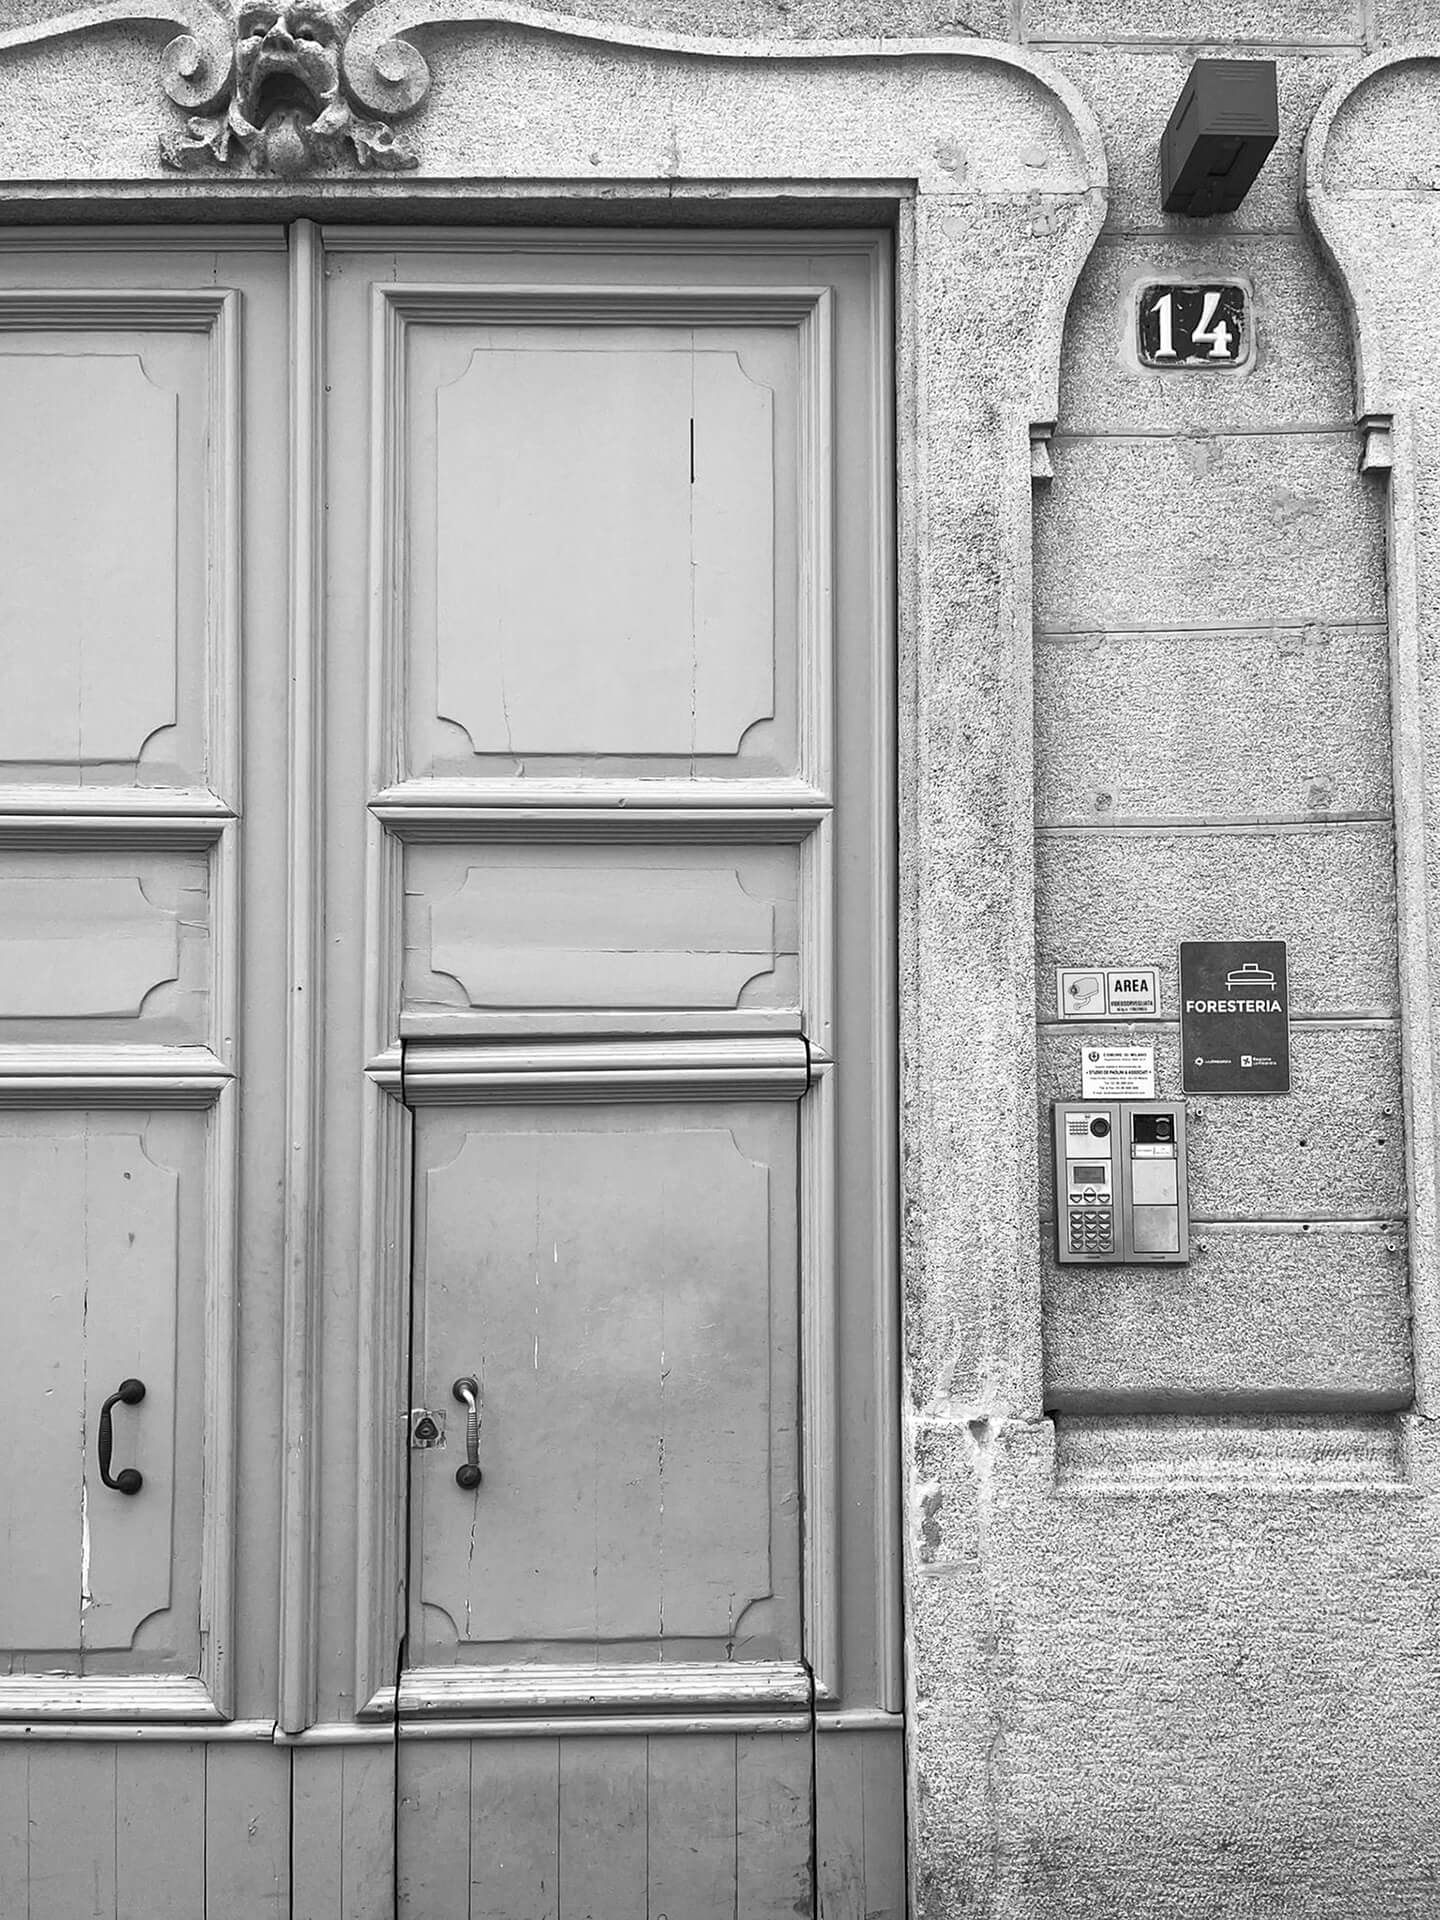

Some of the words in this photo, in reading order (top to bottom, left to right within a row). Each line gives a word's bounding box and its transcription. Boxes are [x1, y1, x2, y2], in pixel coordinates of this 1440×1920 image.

[1150, 291, 1233, 358] 14
[1114, 979, 1148, 992] AREA
[1186, 1000, 1282, 1013] FORESTERIA
